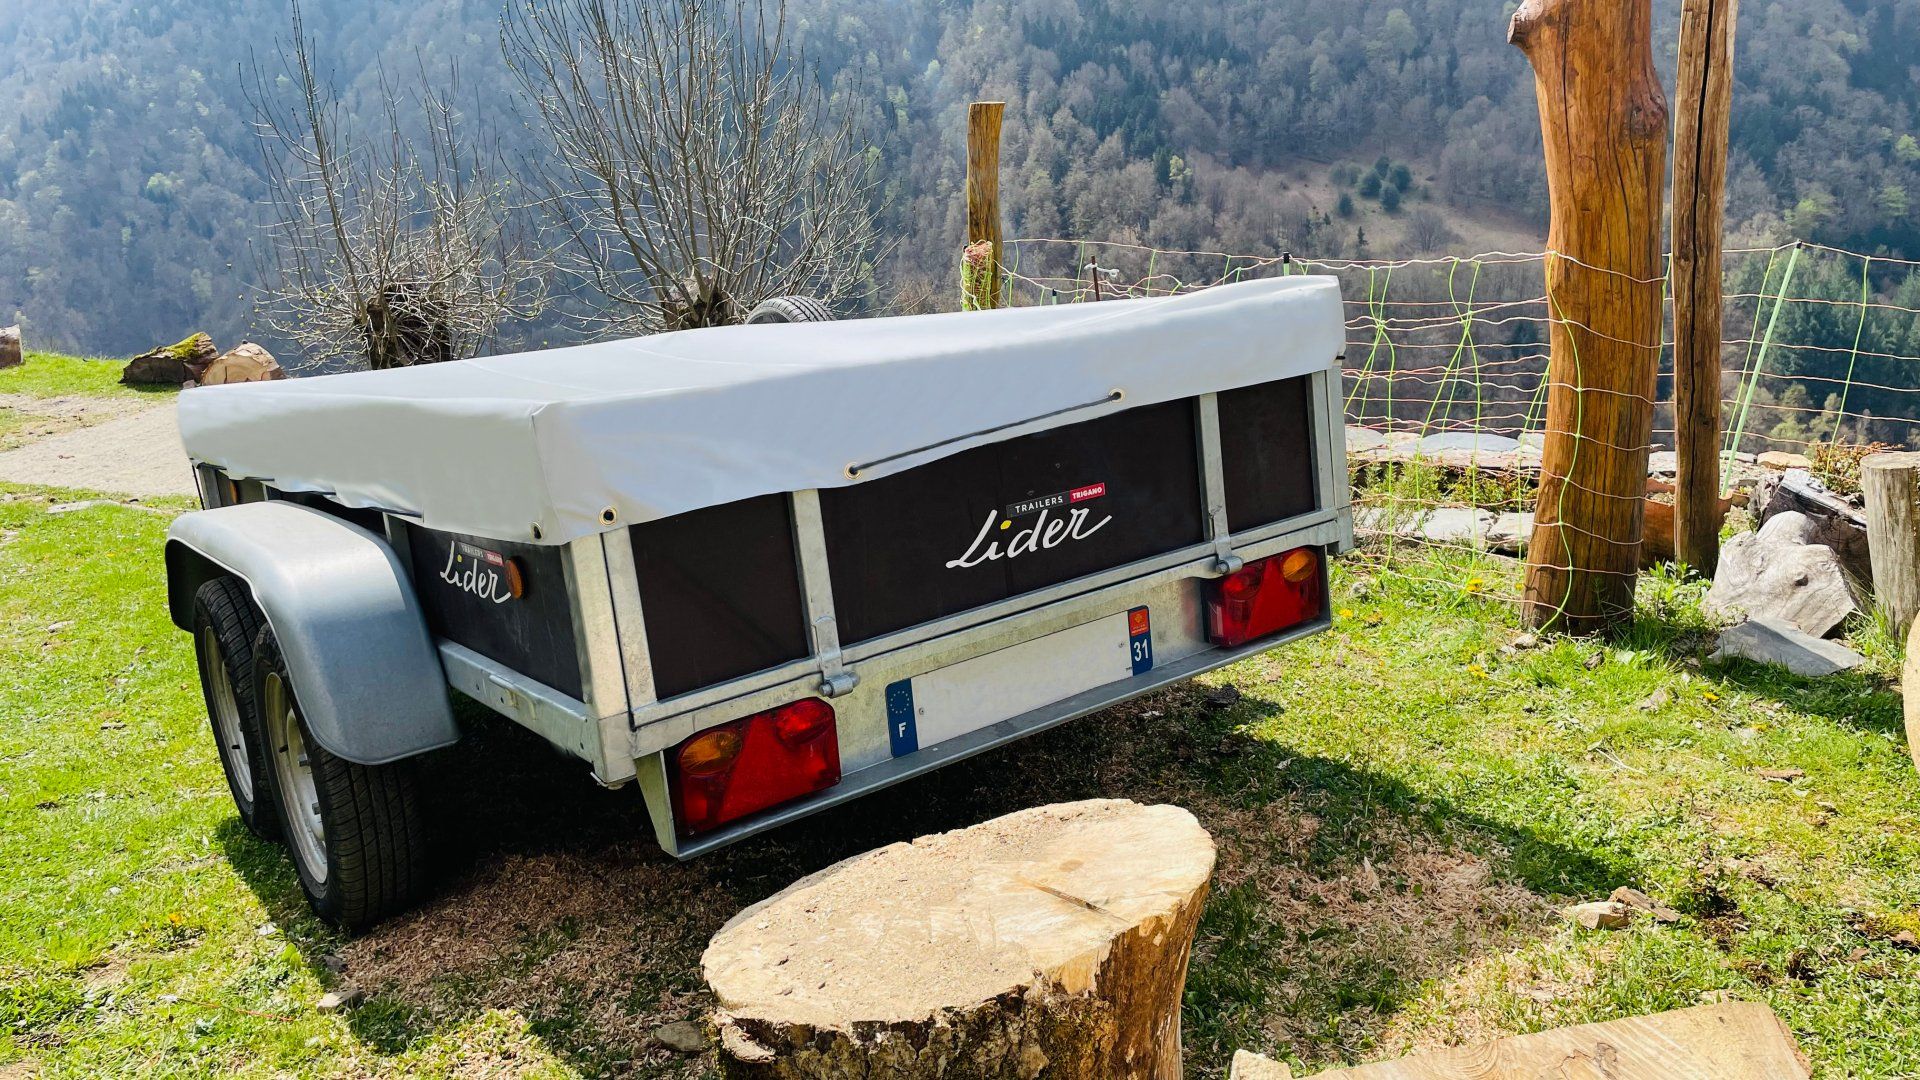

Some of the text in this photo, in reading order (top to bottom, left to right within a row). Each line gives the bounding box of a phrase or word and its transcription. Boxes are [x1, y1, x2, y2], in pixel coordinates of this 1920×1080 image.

[1015, 486, 1102, 513] TRAILERS TRIGANO
[946, 509, 1112, 568] Lider
[440, 540, 511, 603] Lider
[1133, 638, 1149, 661] 31
[898, 722, 906, 737] F
